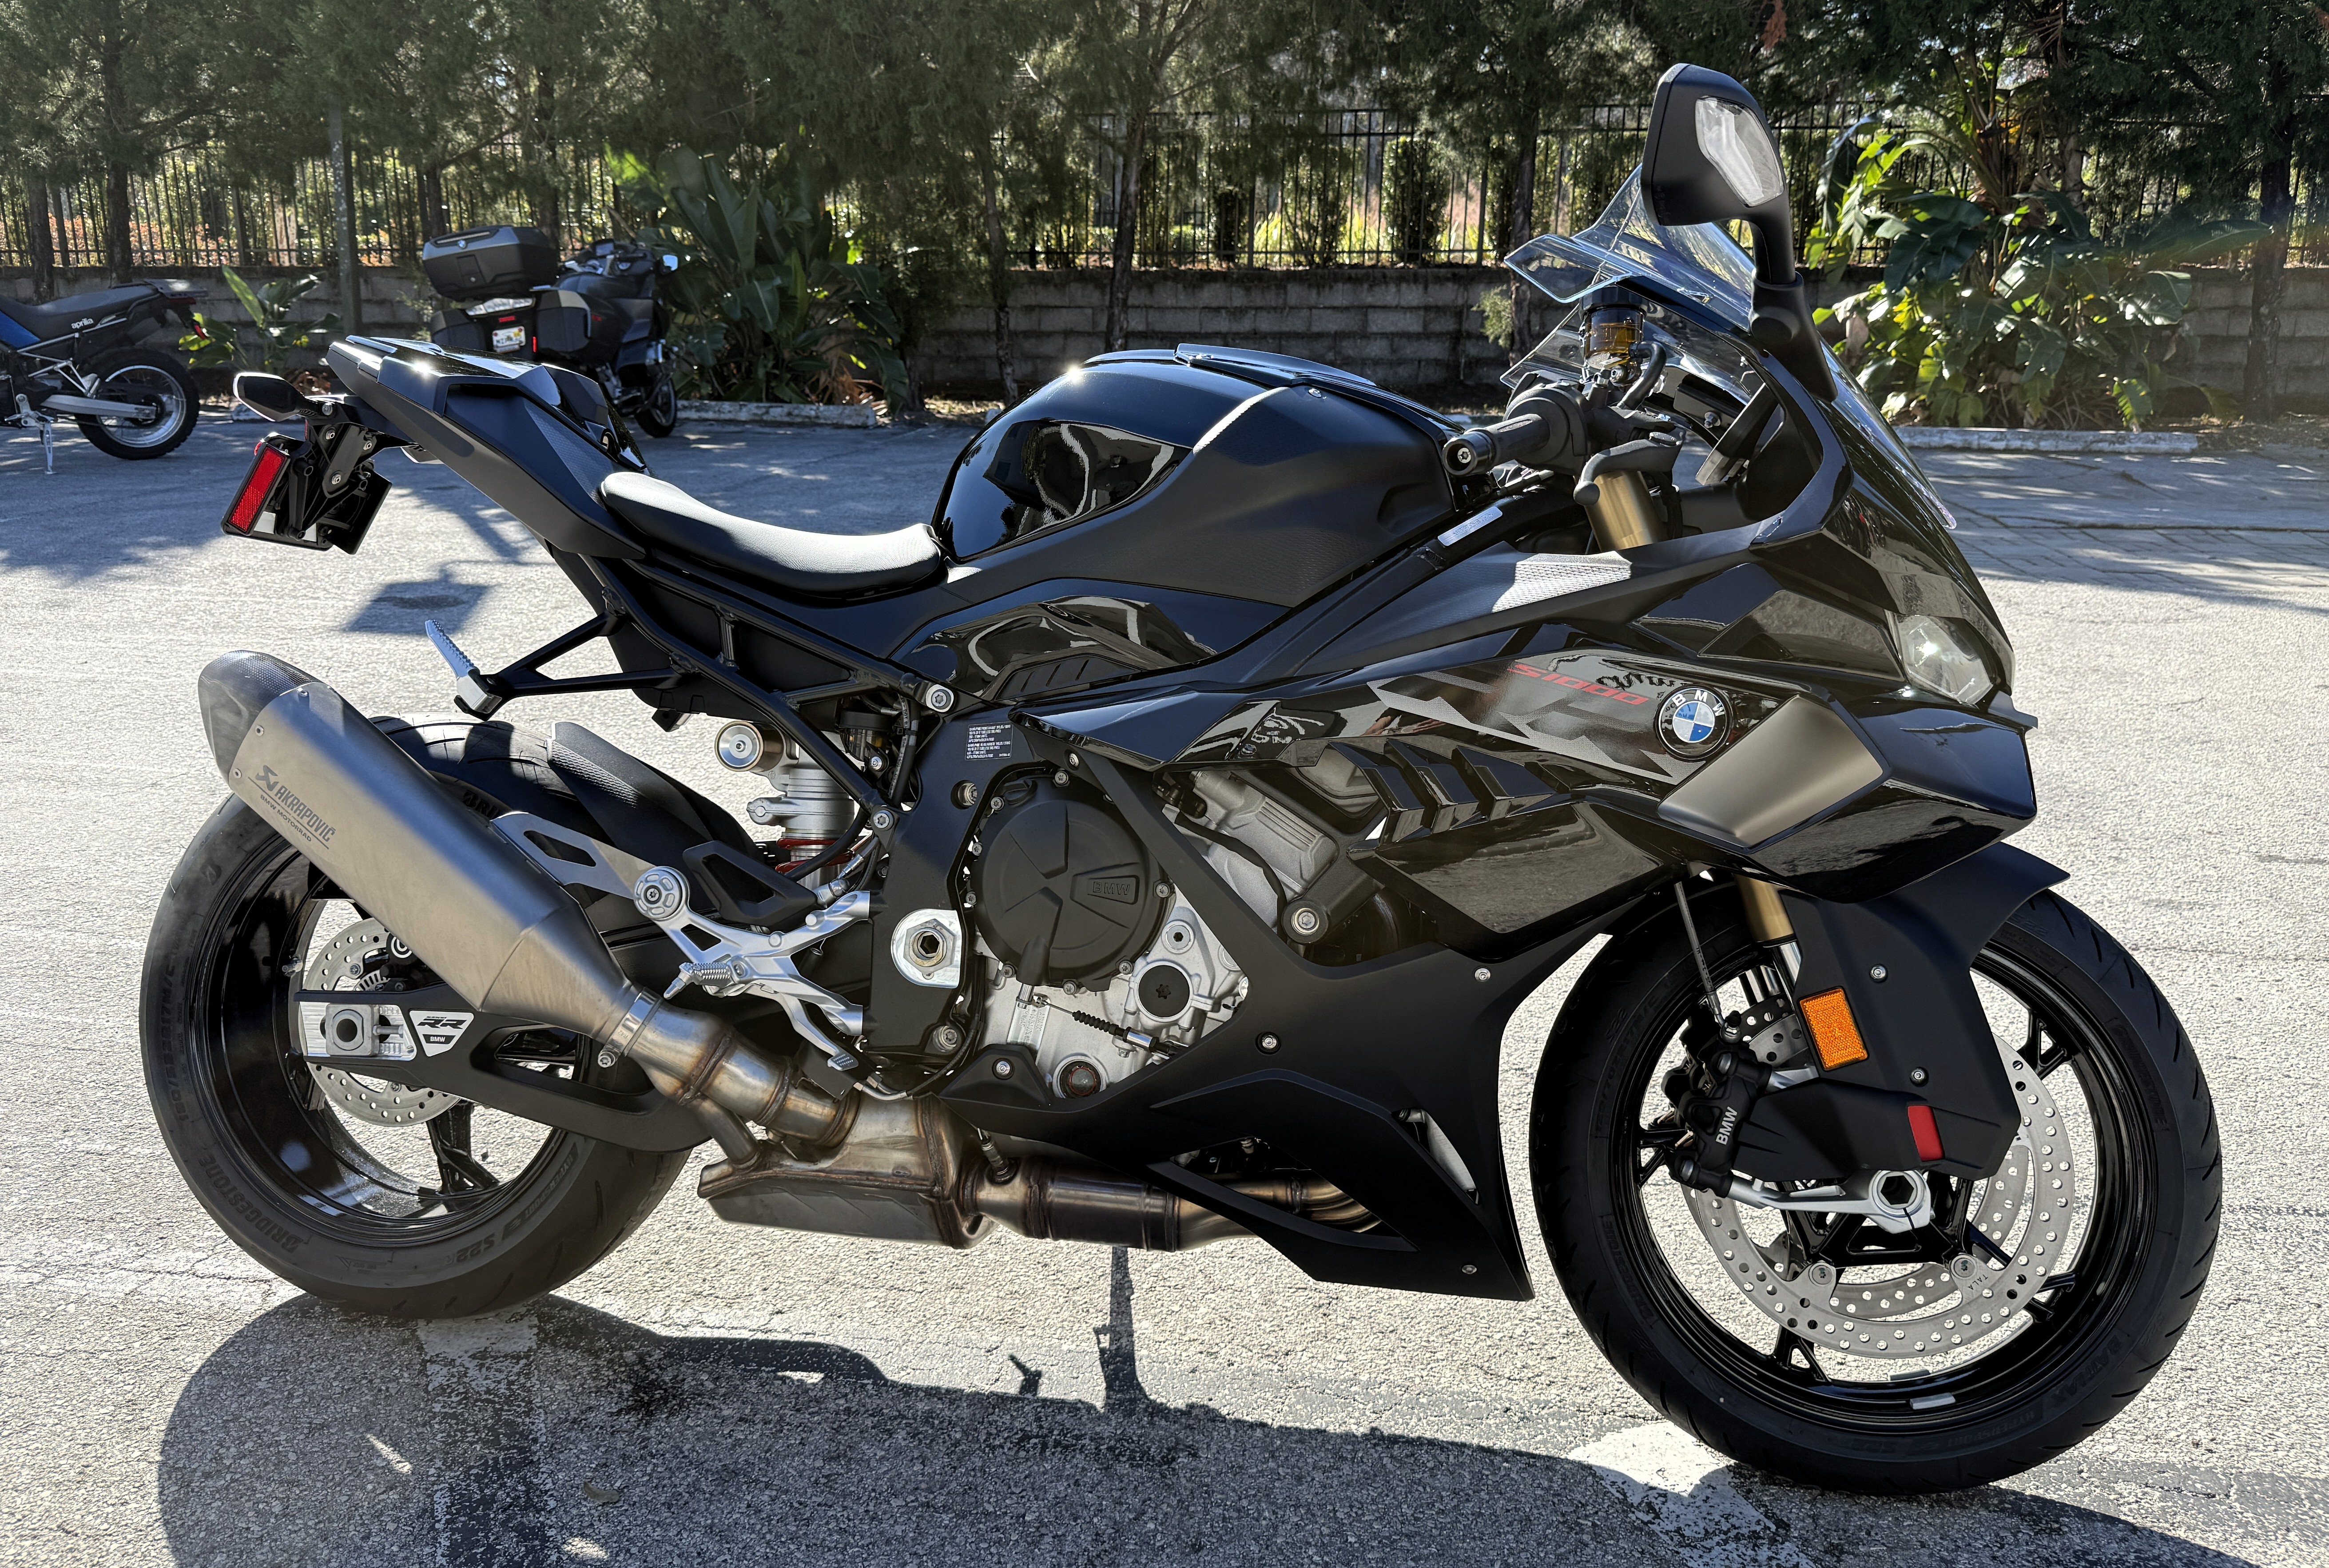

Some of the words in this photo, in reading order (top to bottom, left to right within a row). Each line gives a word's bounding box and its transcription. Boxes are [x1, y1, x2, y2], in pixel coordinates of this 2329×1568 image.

[71, 318, 94, 329] aprilia
[1507, 664, 1649, 705] S1000
[1672, 690, 1725, 717] BMW
[260, 794, 276, 810] BMW
[277, 809, 312, 842] MOTORRAD
[1093, 881, 1130, 895] BMW
[417, 1018, 467, 1029] RR
[1716, 1106, 1737, 1145] BMW
[199, 1153, 302, 1253] BRIDGESTONE
[524, 1155, 574, 1219] HYPERSPORT
[1968, 1274, 1988, 1290] TALA
[2051, 1335, 2125, 1405] BATTLAX
